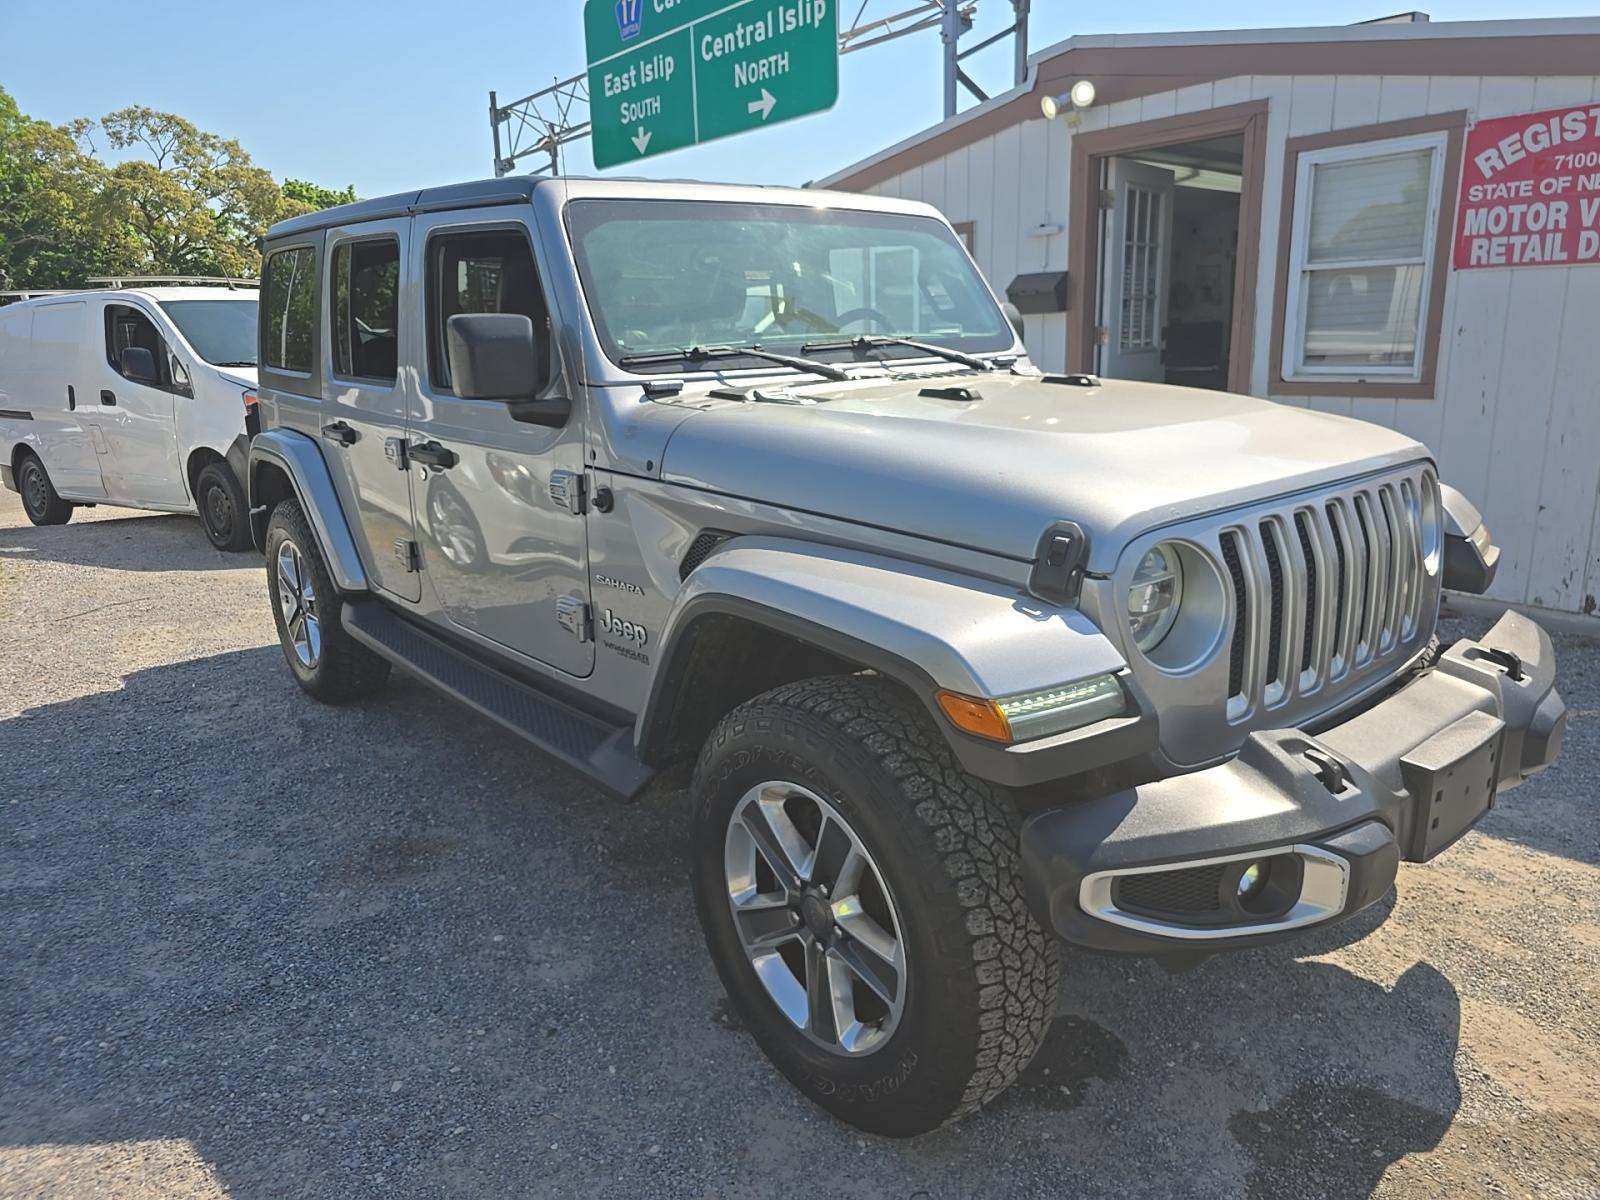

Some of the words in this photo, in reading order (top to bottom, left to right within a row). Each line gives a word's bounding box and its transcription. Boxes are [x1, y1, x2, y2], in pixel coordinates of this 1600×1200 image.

[701, 12, 773, 61] Central
[779, 0, 826, 35] Islip
[604, 66, 637, 97] East
[641, 54, 675, 86] Islip
[734, 52, 789, 88] NORTH
[620, 95, 661, 125] SOUTH
[1555, 151, 1600, 170] 7100
[1469, 180, 1534, 202] STATE
[1540, 176, 1572, 196] OF
[1464, 201, 1568, 236] MOTOR
[1470, 232, 1568, 265] RETAIL
[595, 574, 645, 596] SAHARA
[600, 608, 648, 649] Jeep
